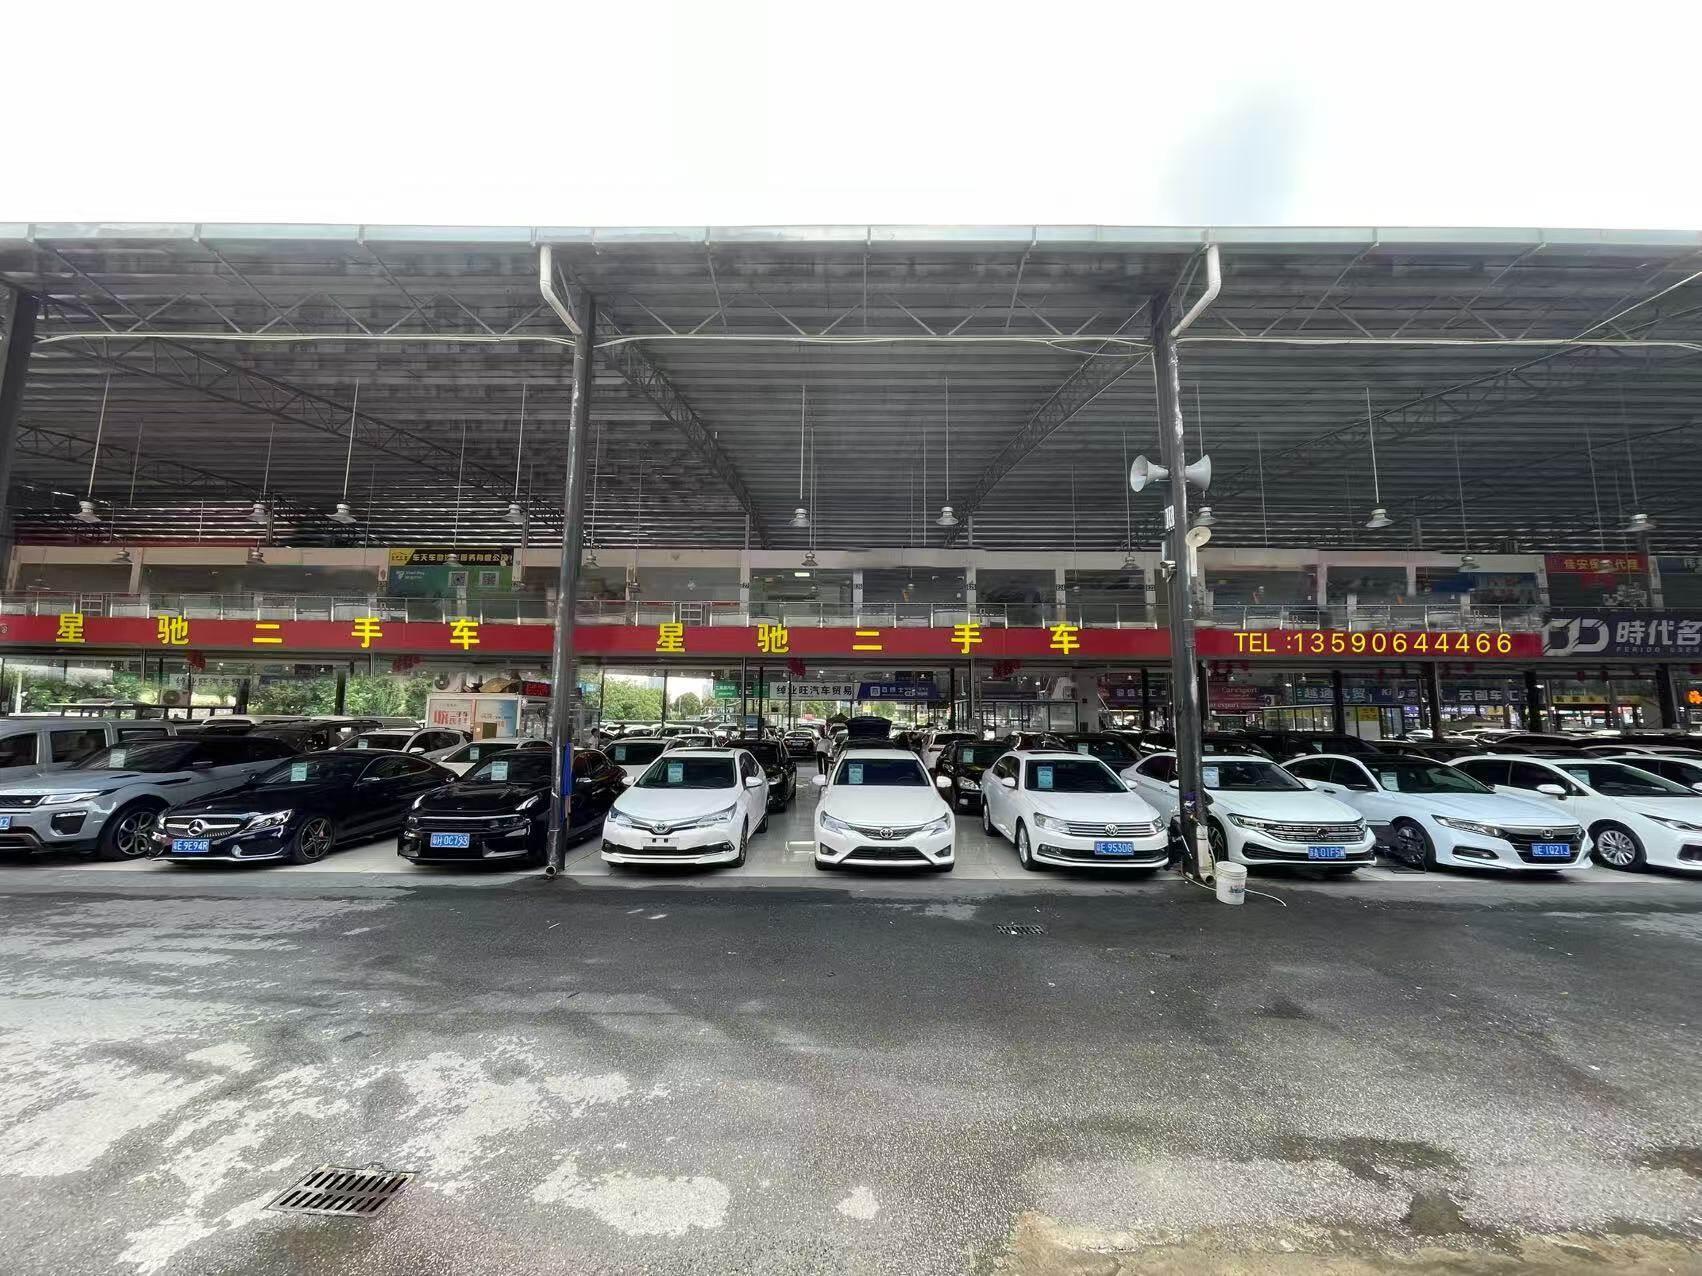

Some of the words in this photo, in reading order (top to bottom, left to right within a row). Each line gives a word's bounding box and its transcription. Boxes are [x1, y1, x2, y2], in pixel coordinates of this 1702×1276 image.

[55, 614, 481, 650] 星驰二手车
[655, 622, 1081, 655] 星驰二手车
[1234, 633, 1276, 653] TEL
[1286, 632, 1512, 653] :13590644466
[1615, 619, 1702, 646] 時代名
